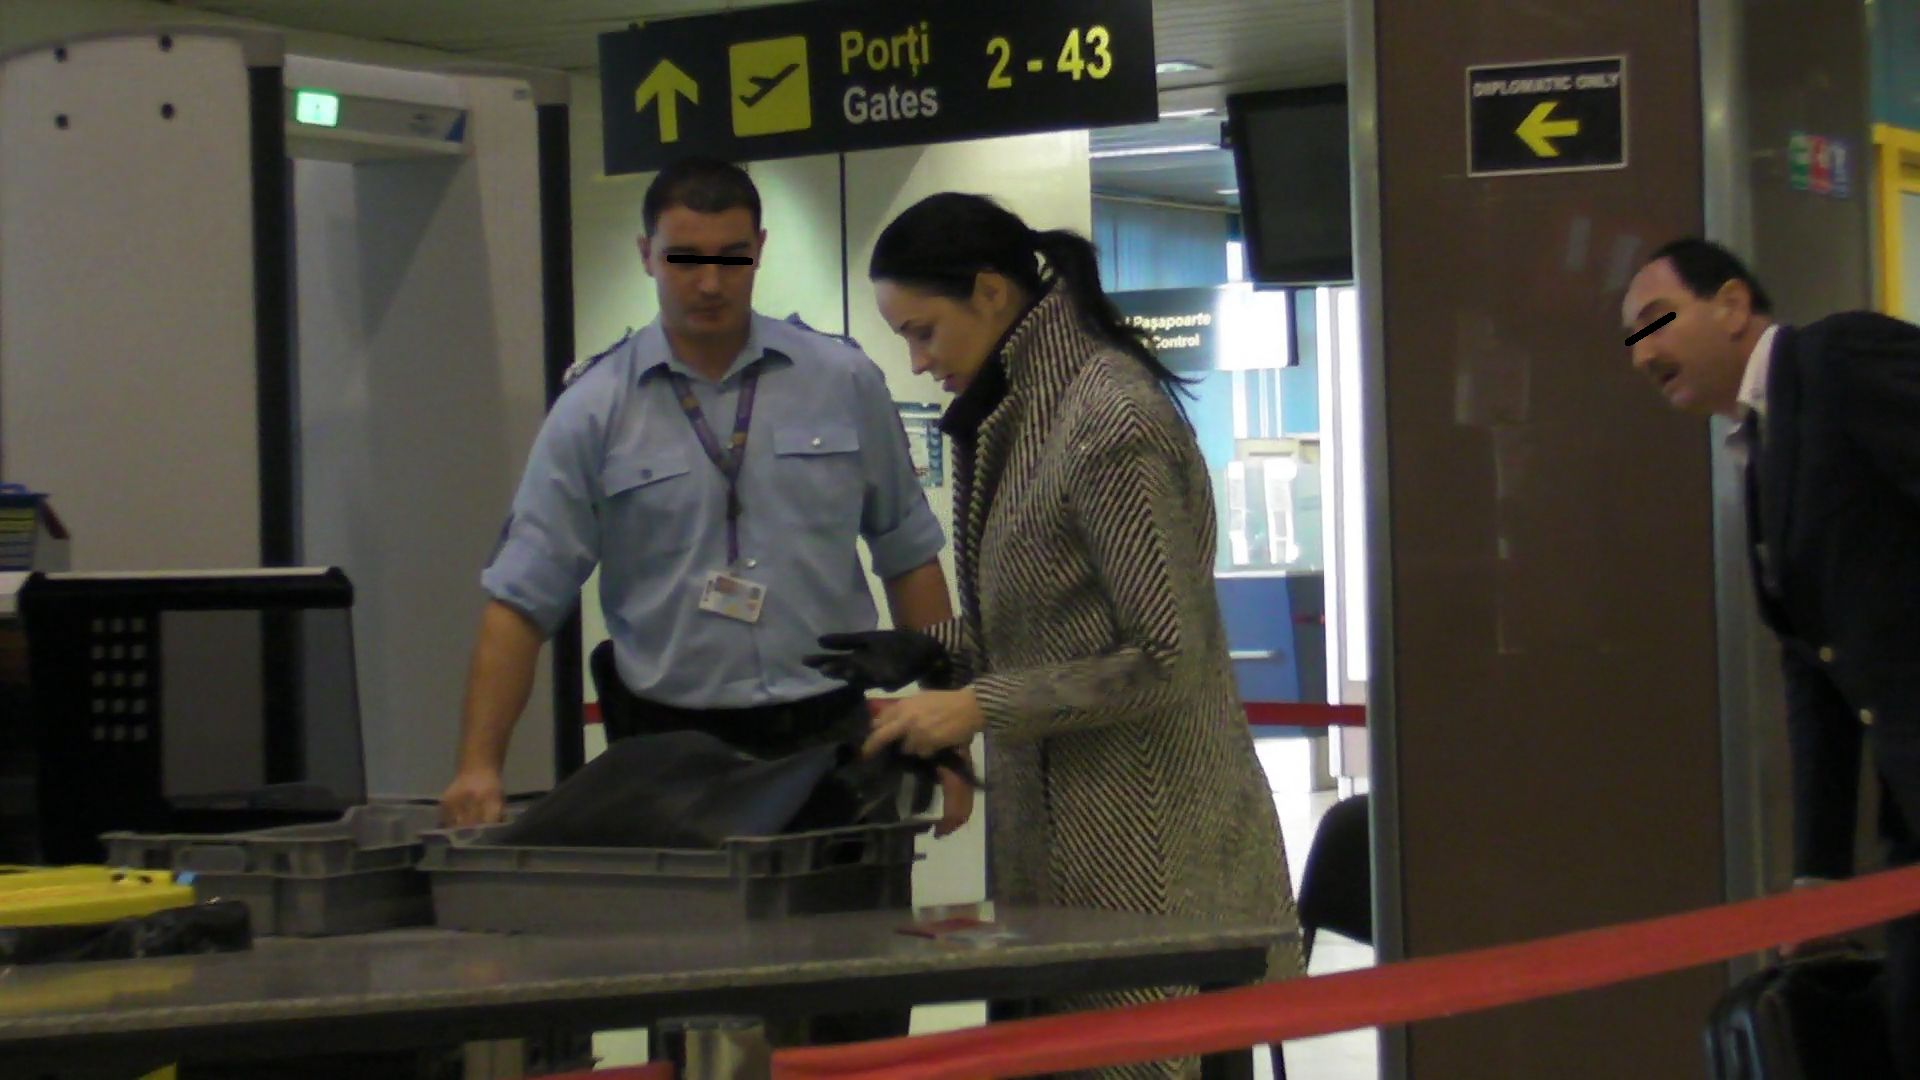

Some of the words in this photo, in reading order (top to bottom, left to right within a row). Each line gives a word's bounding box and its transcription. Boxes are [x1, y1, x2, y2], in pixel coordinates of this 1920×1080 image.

[986, 37, 1012, 89] 2
[1056, 25, 1112, 81] 43
[843, 86, 938, 124] Gates
